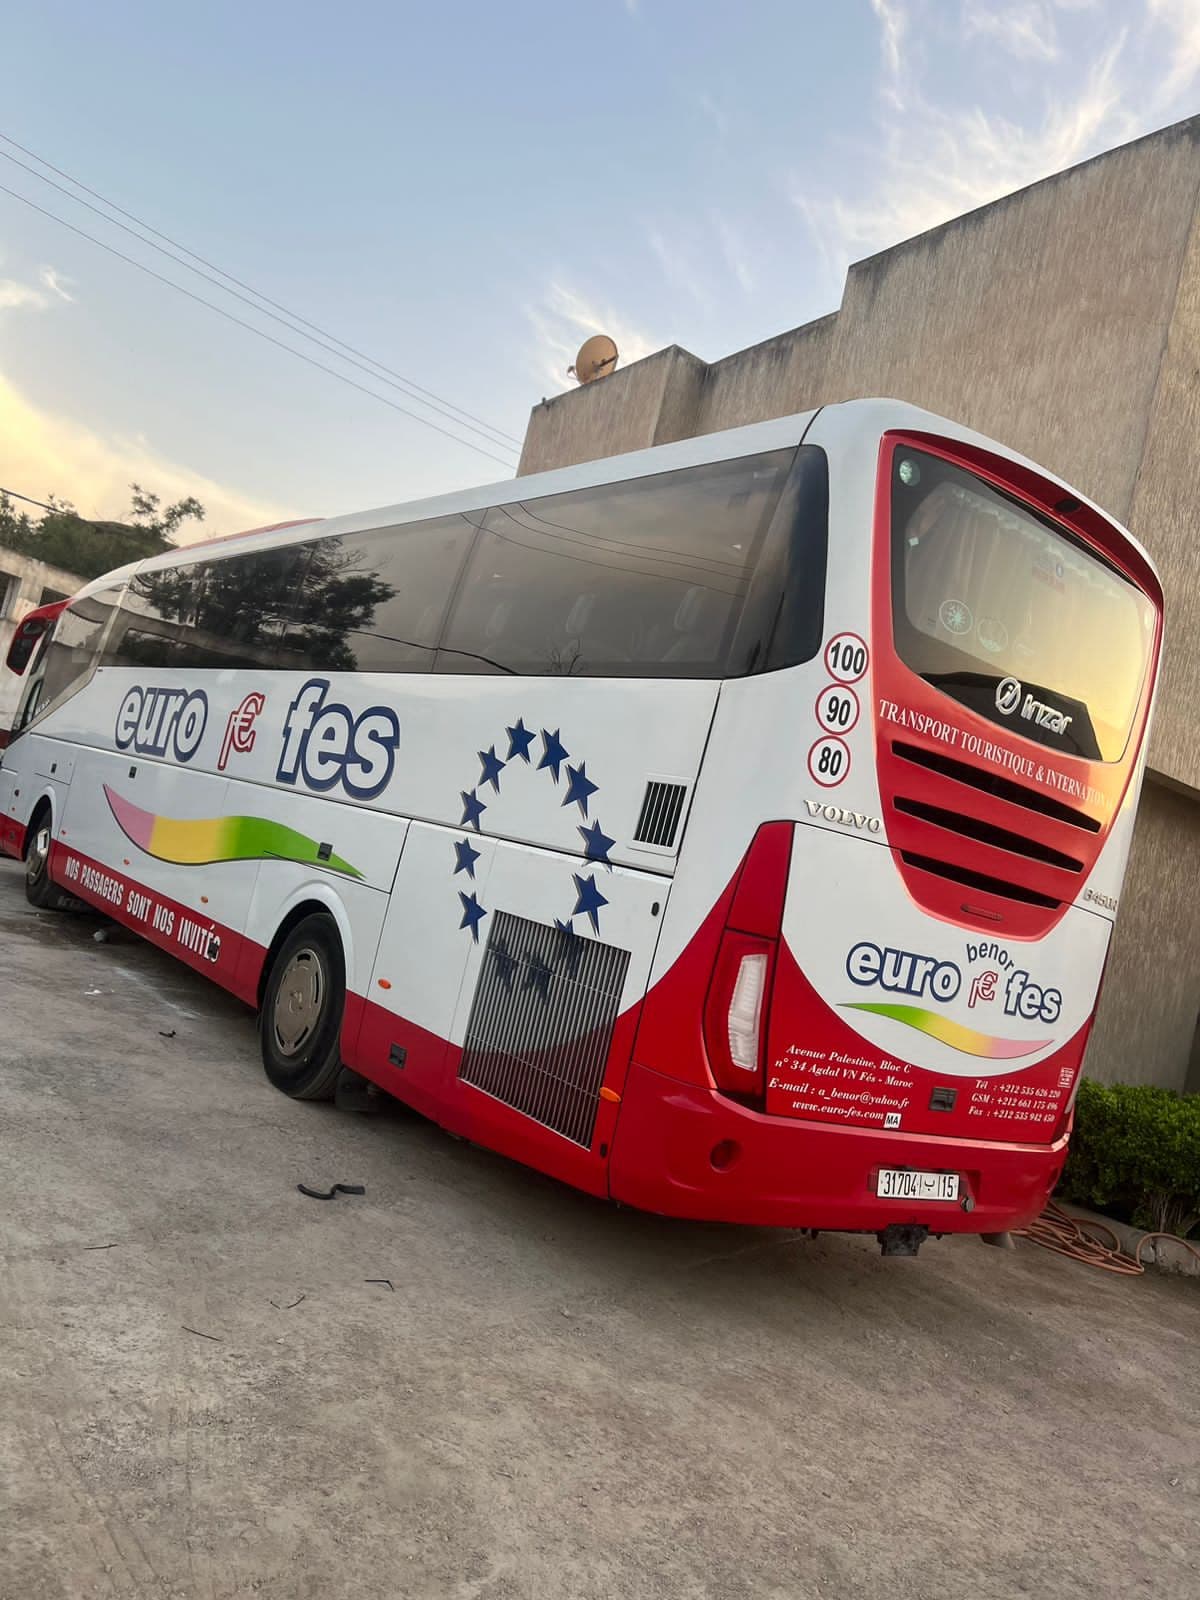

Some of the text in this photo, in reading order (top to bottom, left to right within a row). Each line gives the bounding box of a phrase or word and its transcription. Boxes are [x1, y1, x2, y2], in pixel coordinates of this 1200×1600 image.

[830, 642, 865, 674] 100
[826, 695, 851, 726] 90
[115, 685, 208, 761] euro
[276, 678, 400, 800] fes
[879, 699, 959, 745] TRANSPORT
[961, 731, 1035, 777] TOURISTIQUE
[1035, 766, 1044, 782] &
[818, 746, 841, 776] 80
[803, 800, 881, 833] VOLVO
[65, 856, 80, 880] NOS
[80, 865, 124, 906] PASSAGERS
[126, 890, 152, 922] SONT
[152, 903, 175, 936] NOS
[966, 942, 1014, 971] benor
[846, 942, 961, 1002] euro
[1004, 969, 1062, 1023] fes
[786, 1044, 826, 1060] Avenue
[880, 1060, 901, 1072] Bloc
[903, 1063, 912, 1073] C
[790, 1059, 807, 1072] 34
[808, 1063, 839, 1077] Agdal
[842, 1069, 858, 1079] VN
[885, 1075, 914, 1088] Maroc
[768, 1077, 809, 1094] E-mail
[818, 1087, 910, 1108] a_benor@yahoo.fr
[971, 1092, 990, 1104] GSM
[997, 1096, 1017, 1107] +212
[999, 1084, 1020, 1094] +212
[792, 1100, 884, 1120] www.euro-fes.com
[886, 1114, 898, 1125] MA
[968, 1105, 983, 1116] Fax
[993, 1109, 1014, 1120] +212
[883, 1172, 917, 1196] 31704
[943, 1176, 954, 1197] 15
